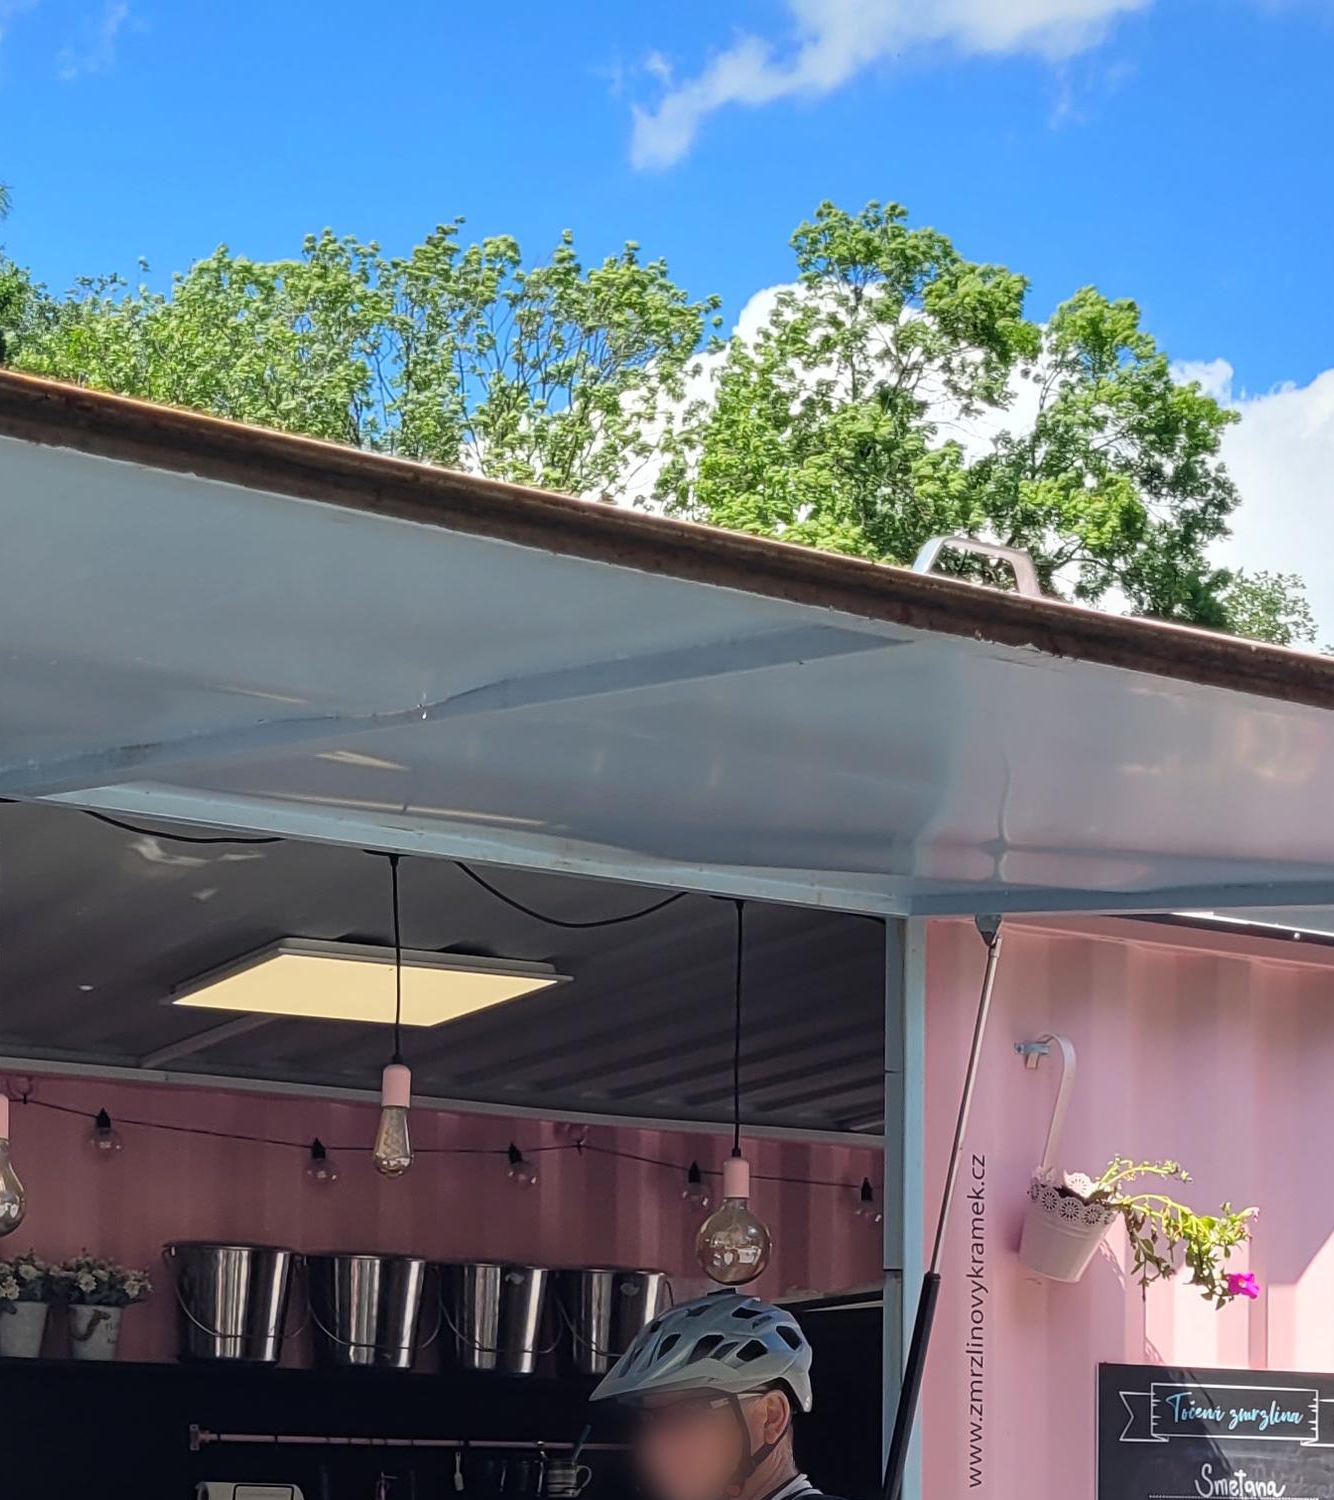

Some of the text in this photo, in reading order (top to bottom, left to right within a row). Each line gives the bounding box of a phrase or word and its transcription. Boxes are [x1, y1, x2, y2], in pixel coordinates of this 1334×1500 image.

[965, 1154, 989, 1488] www.zmrzlinovykramek.cz
[1165, 1391, 1304, 1431] Točená zmrzlina
[1194, 1462, 1286, 1499] Smetana
